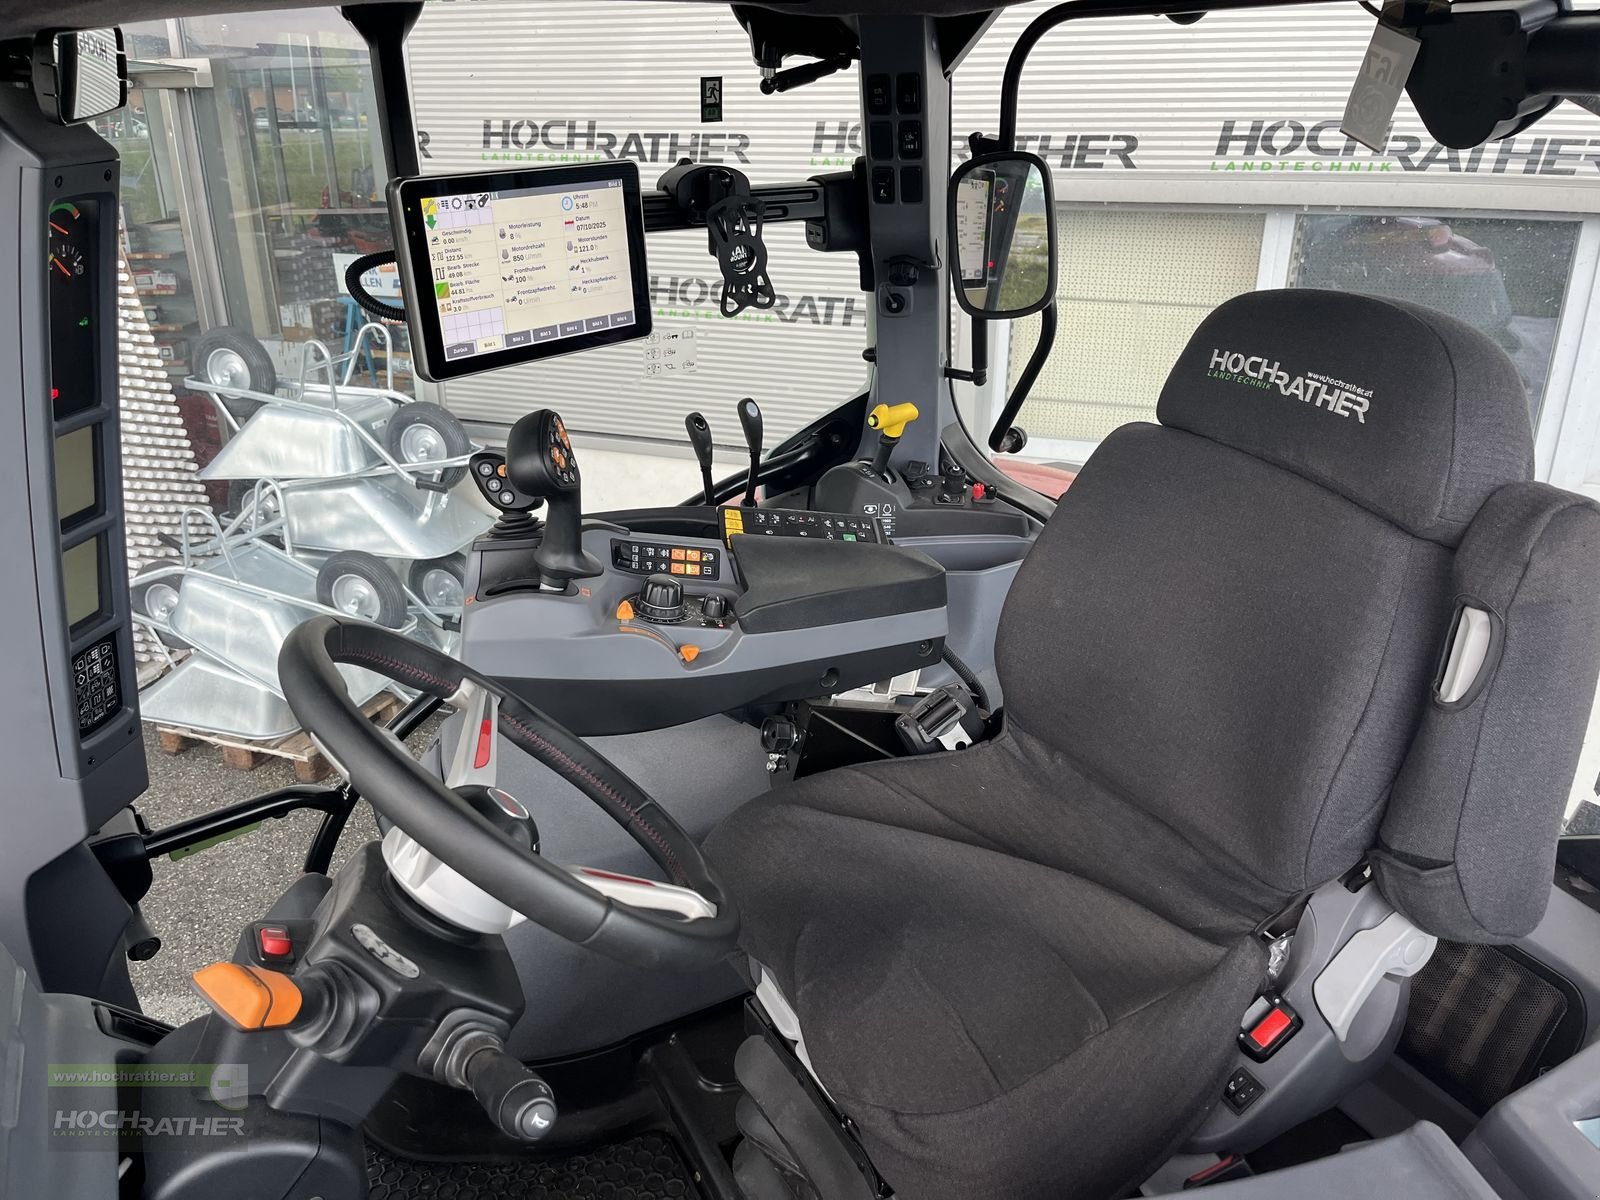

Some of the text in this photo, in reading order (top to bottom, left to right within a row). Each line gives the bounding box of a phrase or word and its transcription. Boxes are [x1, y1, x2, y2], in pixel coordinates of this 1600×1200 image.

[483, 119, 751, 164] HOCHRATHER
[481, 153, 602, 162] LANDTECHNIK
[1211, 161, 1392, 172] LANDTECHNIK
[576, 202, 588, 210] 5:48
[508, 222, 542, 230] Motorleistung
[576, 222, 607, 232] 07/10/2025
[578, 234, 608, 243] Motorstunden
[512, 243, 545, 252] Motordrehzahl
[579, 244, 594, 253] 121.0
[446, 254, 464, 262] 122.55
[512, 254, 524, 262] 850
[580, 255, 609, 264] Heckhubwerk
[514, 265, 546, 274] Fronthubwerk
[516, 276, 526, 284] 100
[452, 294, 494, 304] Kraftstoffverbrauch
[1207, 370, 1273, 390] LANDTECHNIK
[1307, 371, 1373, 398] www.hochrather.at
[1209, 348, 1370, 424] HOCHRATHER
